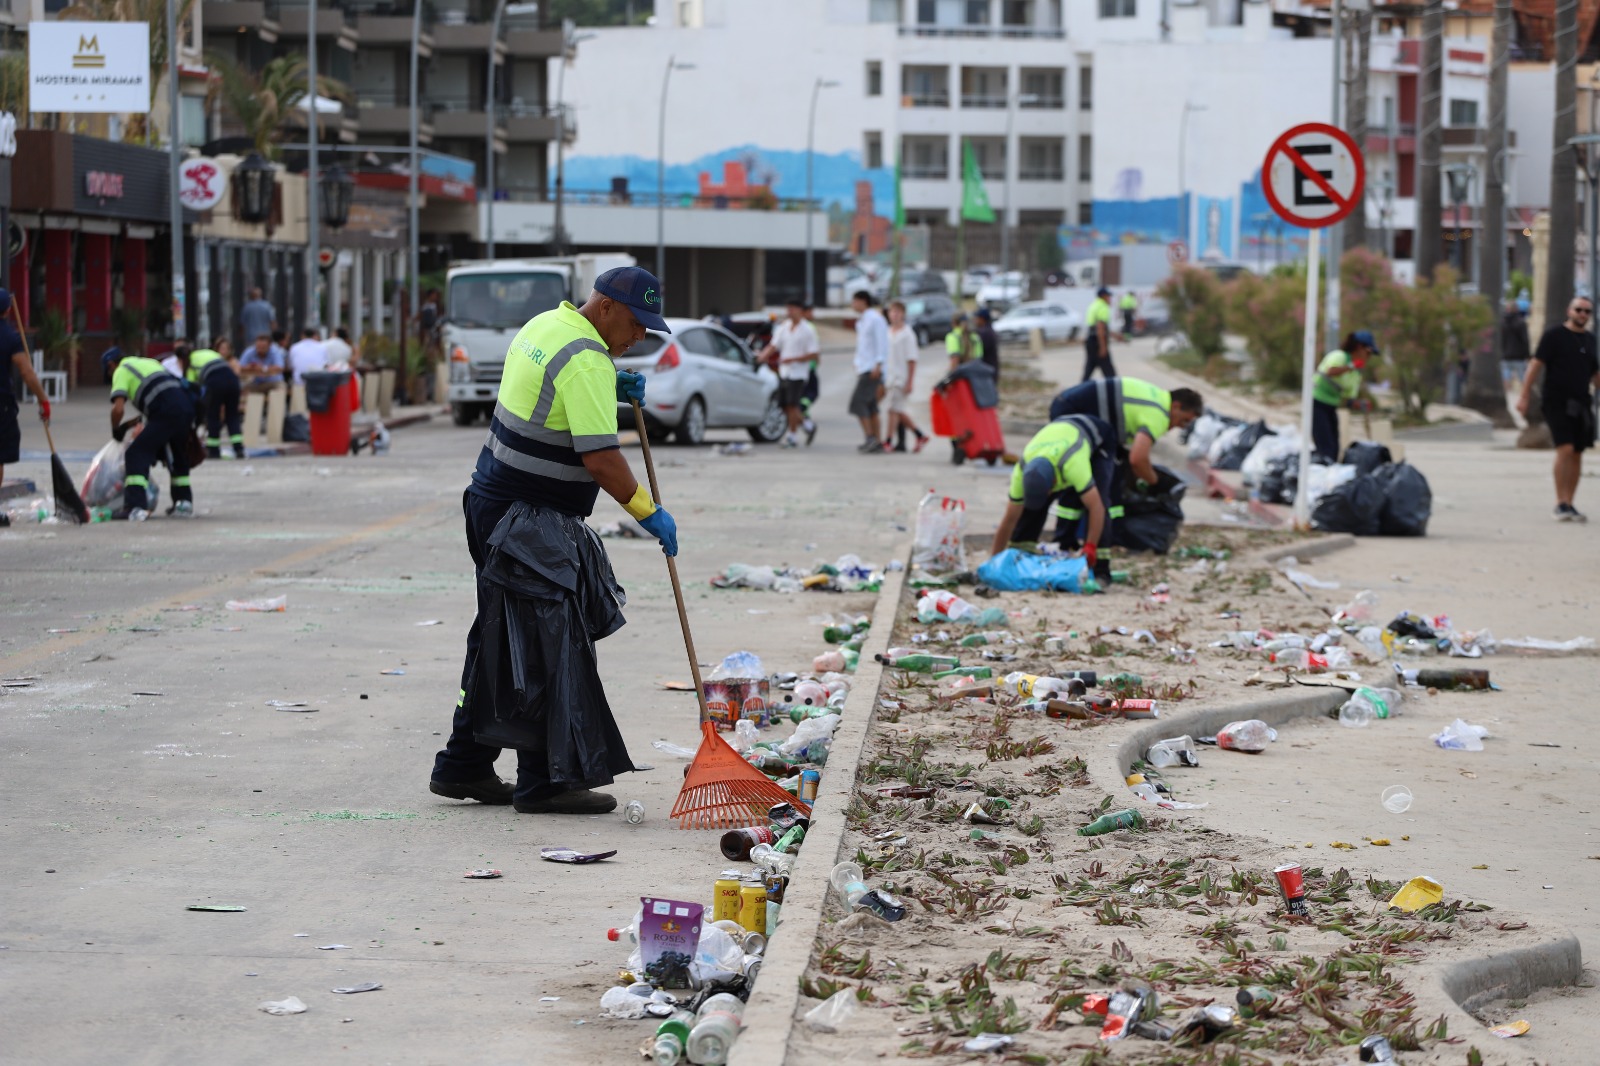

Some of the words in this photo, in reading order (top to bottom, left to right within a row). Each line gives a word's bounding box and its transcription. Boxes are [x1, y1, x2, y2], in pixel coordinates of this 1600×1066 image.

[78, 33, 99, 53] M
[35, 75, 88, 85] HOSTERIA
[91, 75, 143, 85] MIRAMAR
[1294, 144, 1334, 206] E
